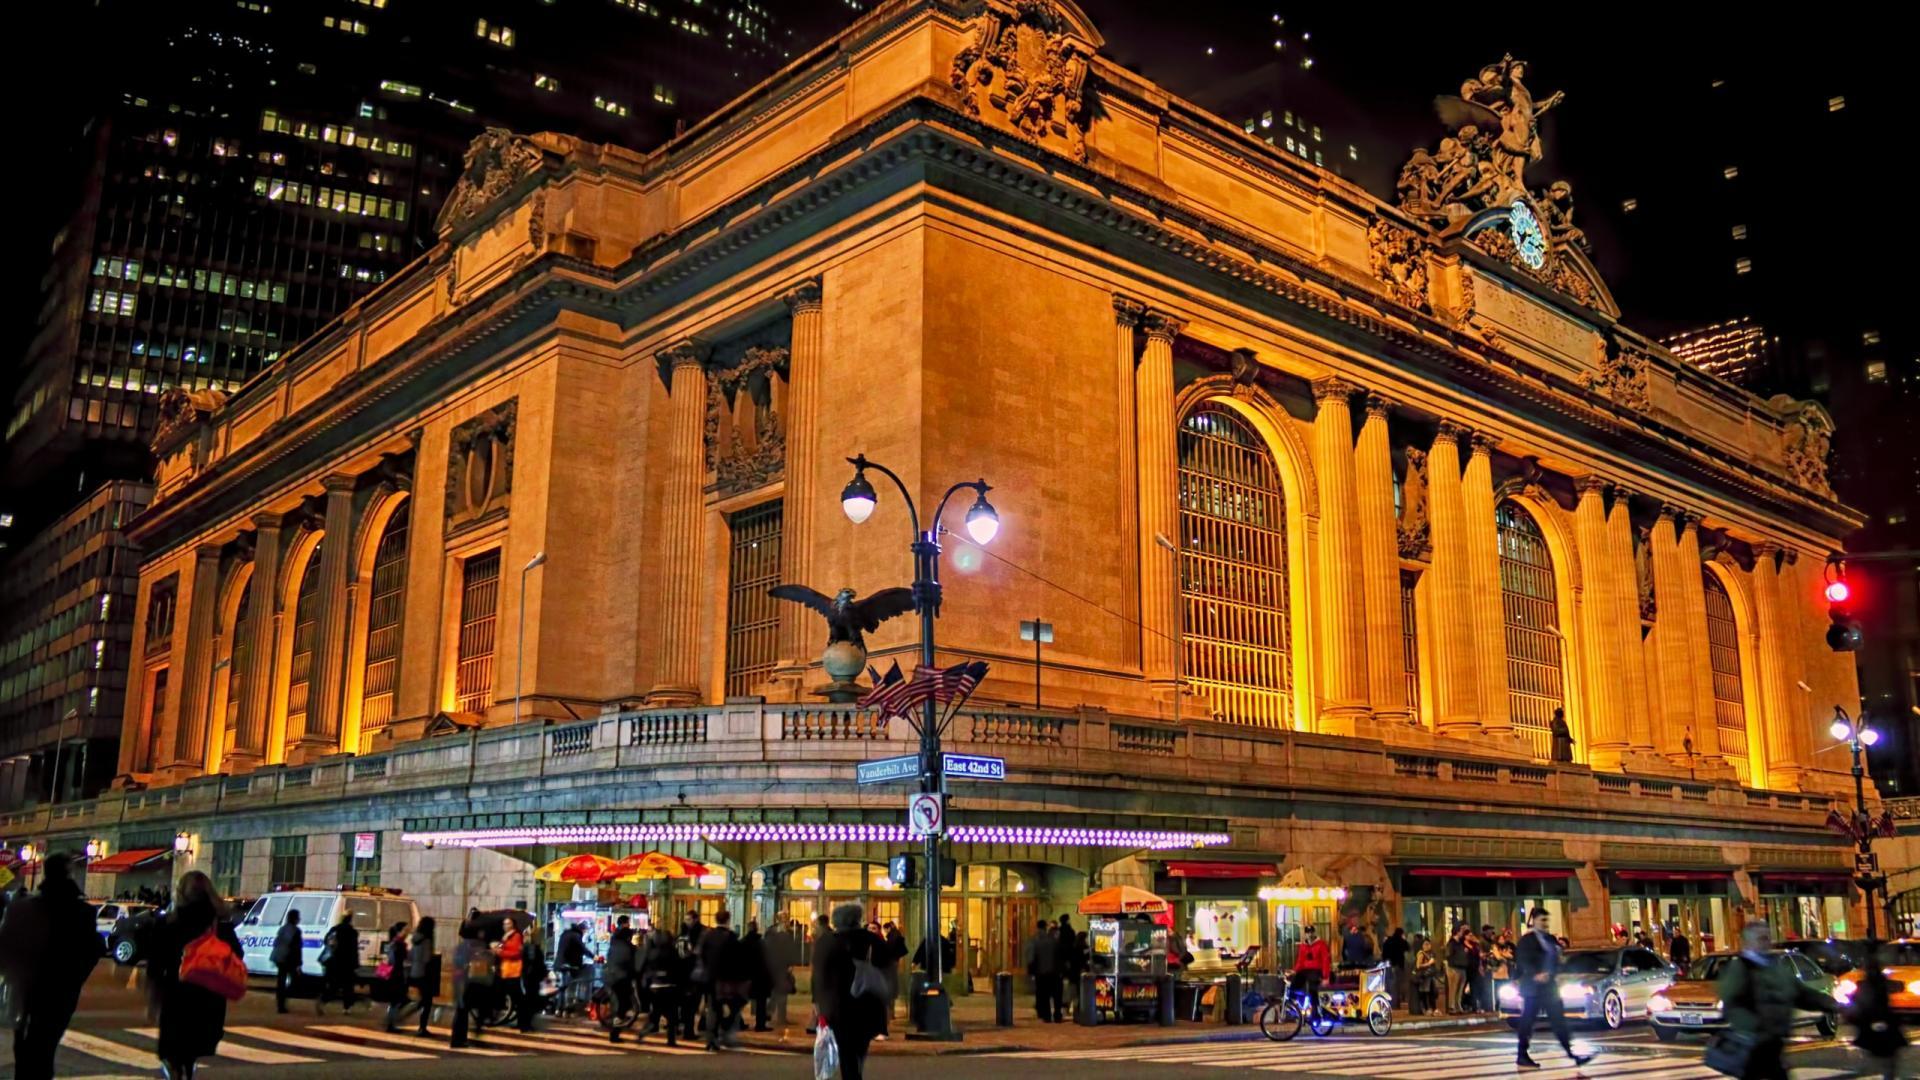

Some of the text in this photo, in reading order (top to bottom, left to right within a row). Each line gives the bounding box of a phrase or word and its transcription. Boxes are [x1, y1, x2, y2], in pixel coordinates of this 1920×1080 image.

[859, 762, 917, 779] Vanderbilt Ave
[946, 760, 1001, 775] East 42nd St
[241, 935, 274, 948] POLICE
